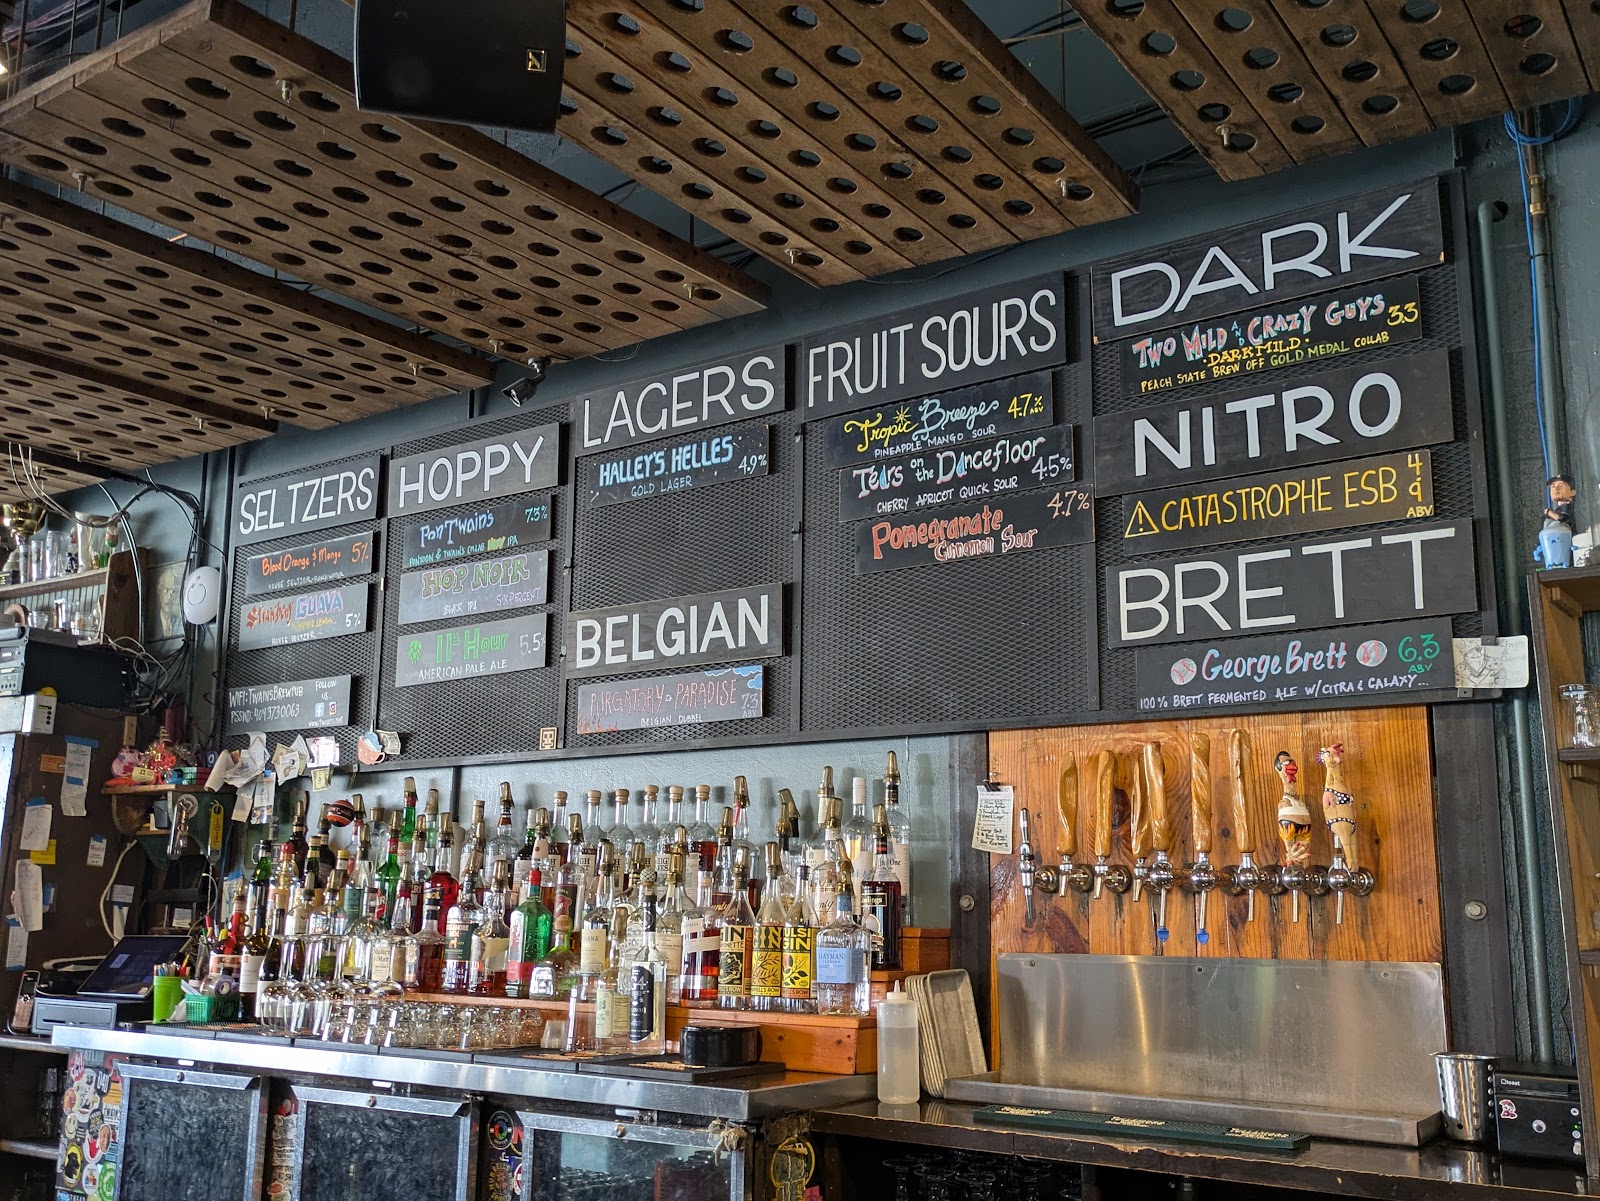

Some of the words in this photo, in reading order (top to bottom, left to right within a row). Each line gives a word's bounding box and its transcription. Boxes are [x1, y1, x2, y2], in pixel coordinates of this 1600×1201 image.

[1111, 193, 1420, 327] DARK
[808, 323, 914, 408] FRUIT
[920, 289, 1056, 379] SOURS
[1132, 336, 1177, 369] TWO
[1181, 325, 1228, 362] MILD
[1231, 320, 1246, 347] AND
[1247, 304, 1317, 347] CRAZY
[1324, 293, 1386, 326] GUYS
[1387, 301, 1419, 326] 3.3
[1140, 374, 1174, 393] PEACH
[1176, 367, 1207, 385] STATE
[1213, 361, 1240, 378] BREW
[1246, 357, 1265, 371] OFF
[1270, 349, 1304, 367] GOLD
[1307, 341, 1350, 360] MEDAL
[1354, 331, 1390, 348] COLLAB
[583, 356, 775, 448] LAGERS
[844, 412, 919, 453] Tropic
[912, 397, 1000, 442] Breeze
[1007, 393, 1043, 419] 4.7%
[874, 440, 923, 459] PINEAPPLE
[927, 432, 964, 448] MANGO
[972, 423, 997, 439] SOUR
[1134, 372, 1402, 477] NITRO
[399, 435, 545, 508] HOPPY
[599, 450, 665, 487] HALLEY'S
[671, 435, 733, 474] HELLES
[738, 453, 767, 476] 4.9%
[910, 456, 924, 469] on
[915, 466, 934, 482] the
[936, 436, 1046, 484] Dancefloor
[1031, 453, 1072, 482] 4.5%
[631, 482, 655, 498] GOLD
[661, 476, 693, 493] LAGER
[853, 465, 903, 498] Tears
[876, 499, 910, 514] CHERRY
[915, 490, 955, 507] APRICOT
[959, 481, 990, 498] QUICK
[993, 475, 1019, 491] SOUR
[1161, 476, 1333, 531] CATASTROPHE
[1344, 466, 1398, 509] ESB
[240, 467, 375, 535] SELTZERS
[525, 505, 548, 524] 7.3%
[1406, 504, 1434, 518] ABV
[872, 504, 1003, 560] Pomegranate
[1047, 490, 1090, 519] 4.7%
[934, 536, 994, 561] Cinnamon
[1001, 524, 1038, 553] Sour
[262, 557, 282, 576] Blood
[283, 554, 310, 570] Orange
[319, 547, 341, 564] Mango
[351, 542, 369, 563] 5%
[409, 552, 434, 567] PONTOON
[435, 548, 442, 561] &
[443, 545, 465, 558] TWAIN'S
[467, 542, 485, 554] COLLAB
[507, 534, 519, 547] IPA
[422, 564, 468, 599] HOP
[471, 554, 530, 591] NOIR
[1119, 527, 1456, 642] BRETT
[295, 590, 344, 620] GUAVA
[346, 612, 361, 628] 5%
[443, 602, 463, 616] BLACK
[467, 600, 478, 612] IPA
[271, 632, 288, 645] HOUSE
[291, 631, 316, 642] SELTZER
[463, 627, 509, 661] Hour
[576, 594, 769, 669] BELGIAN
[418, 664, 463, 682] AMERICAN
[465, 661, 486, 677] PALE
[490, 659, 508, 671] ALE
[1202, 648, 1282, 683] George
[1285, 640, 1348, 675] Brett
[1397, 633, 1441, 663] 6.3
[1408, 663, 1433, 674] ABV
[315, 680, 337, 691] FOLLOW
[590, 684, 665, 717] PURGATORY
[675, 679, 737, 711] PARADISE
[741, 692, 759, 710] 7.3
[1139, 695, 1169, 710] 100%
[1173, 692, 1203, 708] BRETT
[1208, 689, 1267, 705] FERMENTED
[1274, 685, 1298, 700] ALE
[640, 715, 672, 727] BELGIAN
[678, 713, 703, 723] DUBBEL
[742, 709, 757, 718] ABV
